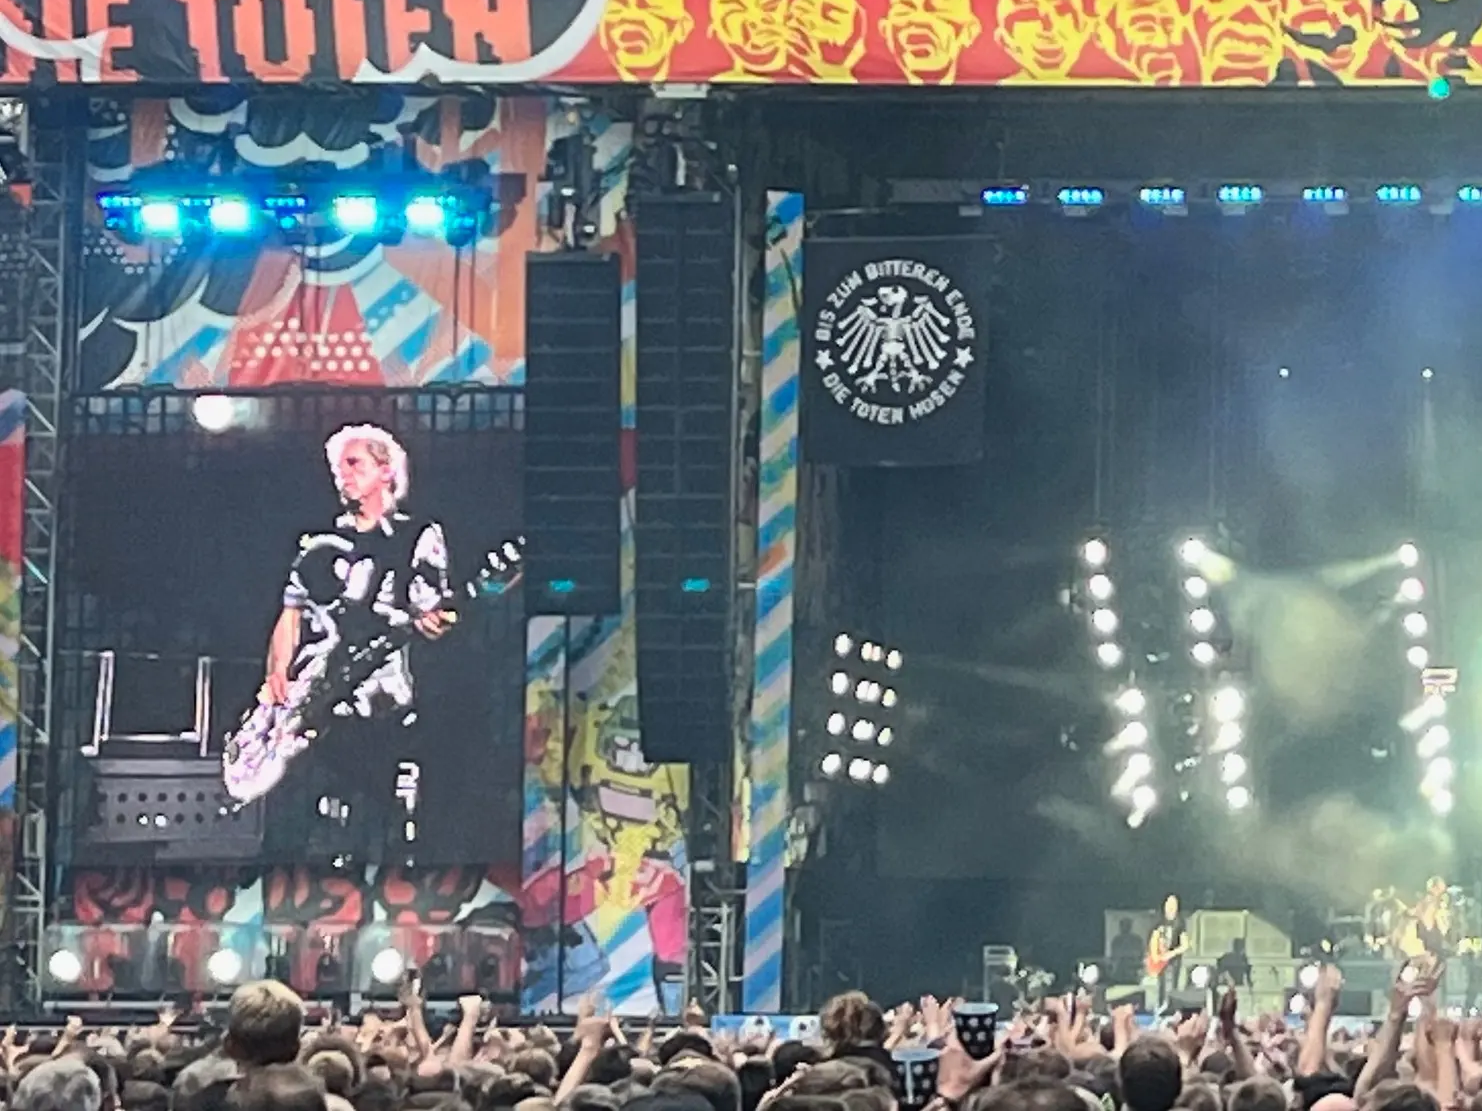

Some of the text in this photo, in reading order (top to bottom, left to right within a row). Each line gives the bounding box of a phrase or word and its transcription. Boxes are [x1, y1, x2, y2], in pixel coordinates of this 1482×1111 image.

[826, 270, 864, 309] ZUM
[864, 259, 950, 293] BITTEREN
[944, 288, 976, 341] ENDE
[821, 369, 966, 425] DIE TOTEN HOSEN
